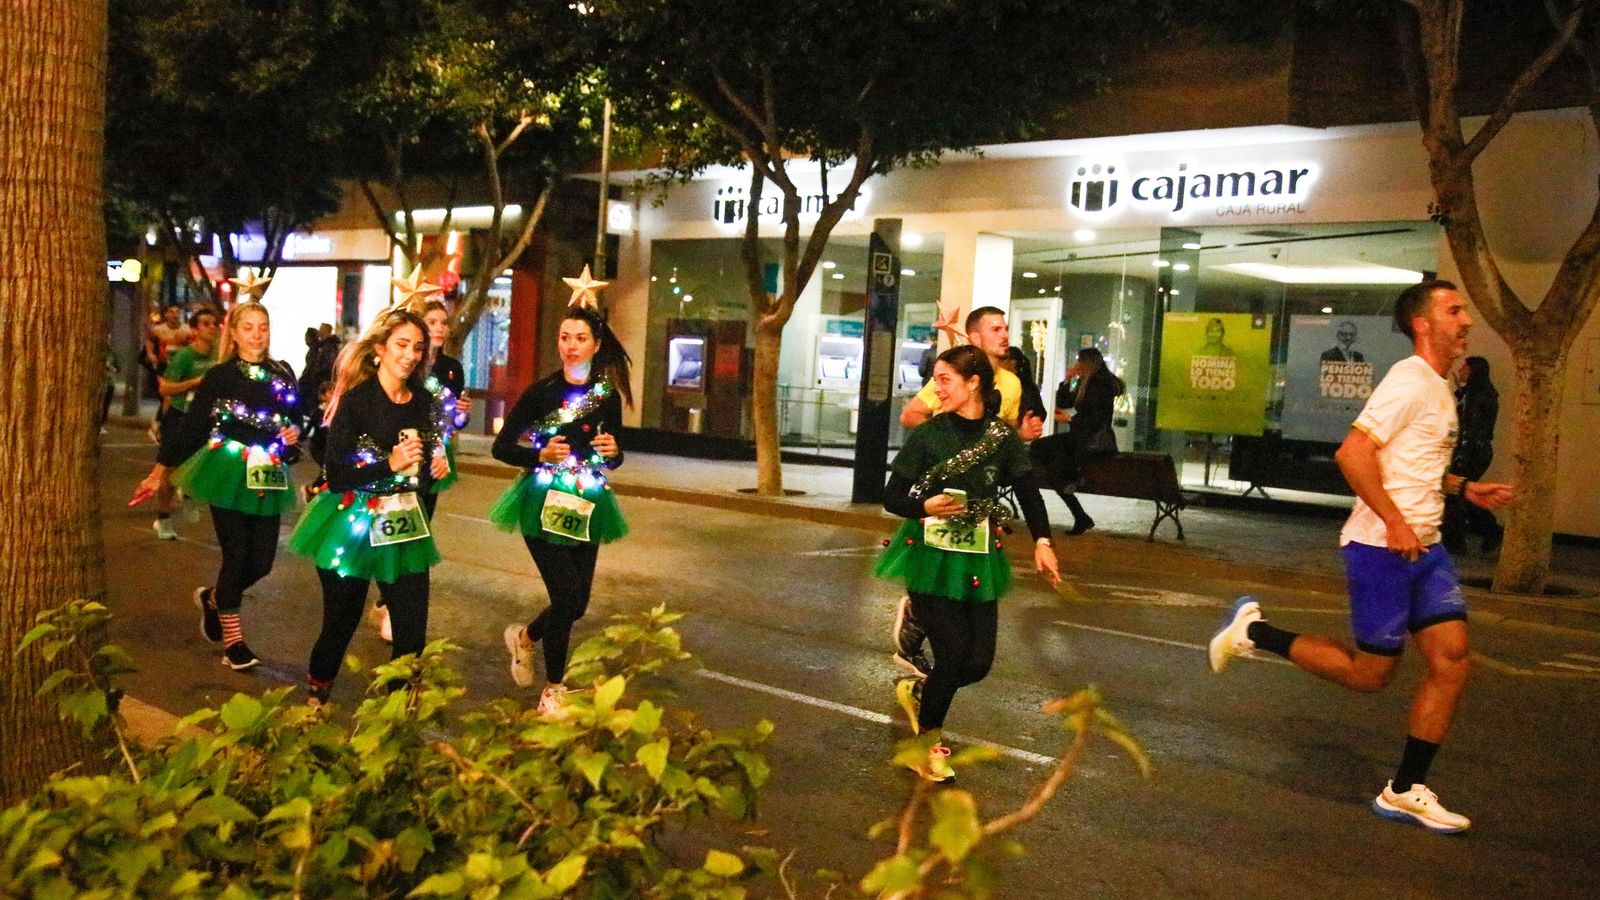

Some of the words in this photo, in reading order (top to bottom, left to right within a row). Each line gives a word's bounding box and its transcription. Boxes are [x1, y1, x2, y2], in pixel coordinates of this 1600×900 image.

[1131, 163, 1309, 212] cajamar
[1216, 205, 1251, 216] CAJA
[1256, 202, 1305, 215] RURAL
[1191, 376, 1236, 391] TODO
[1320, 383, 1373, 400] TODO
